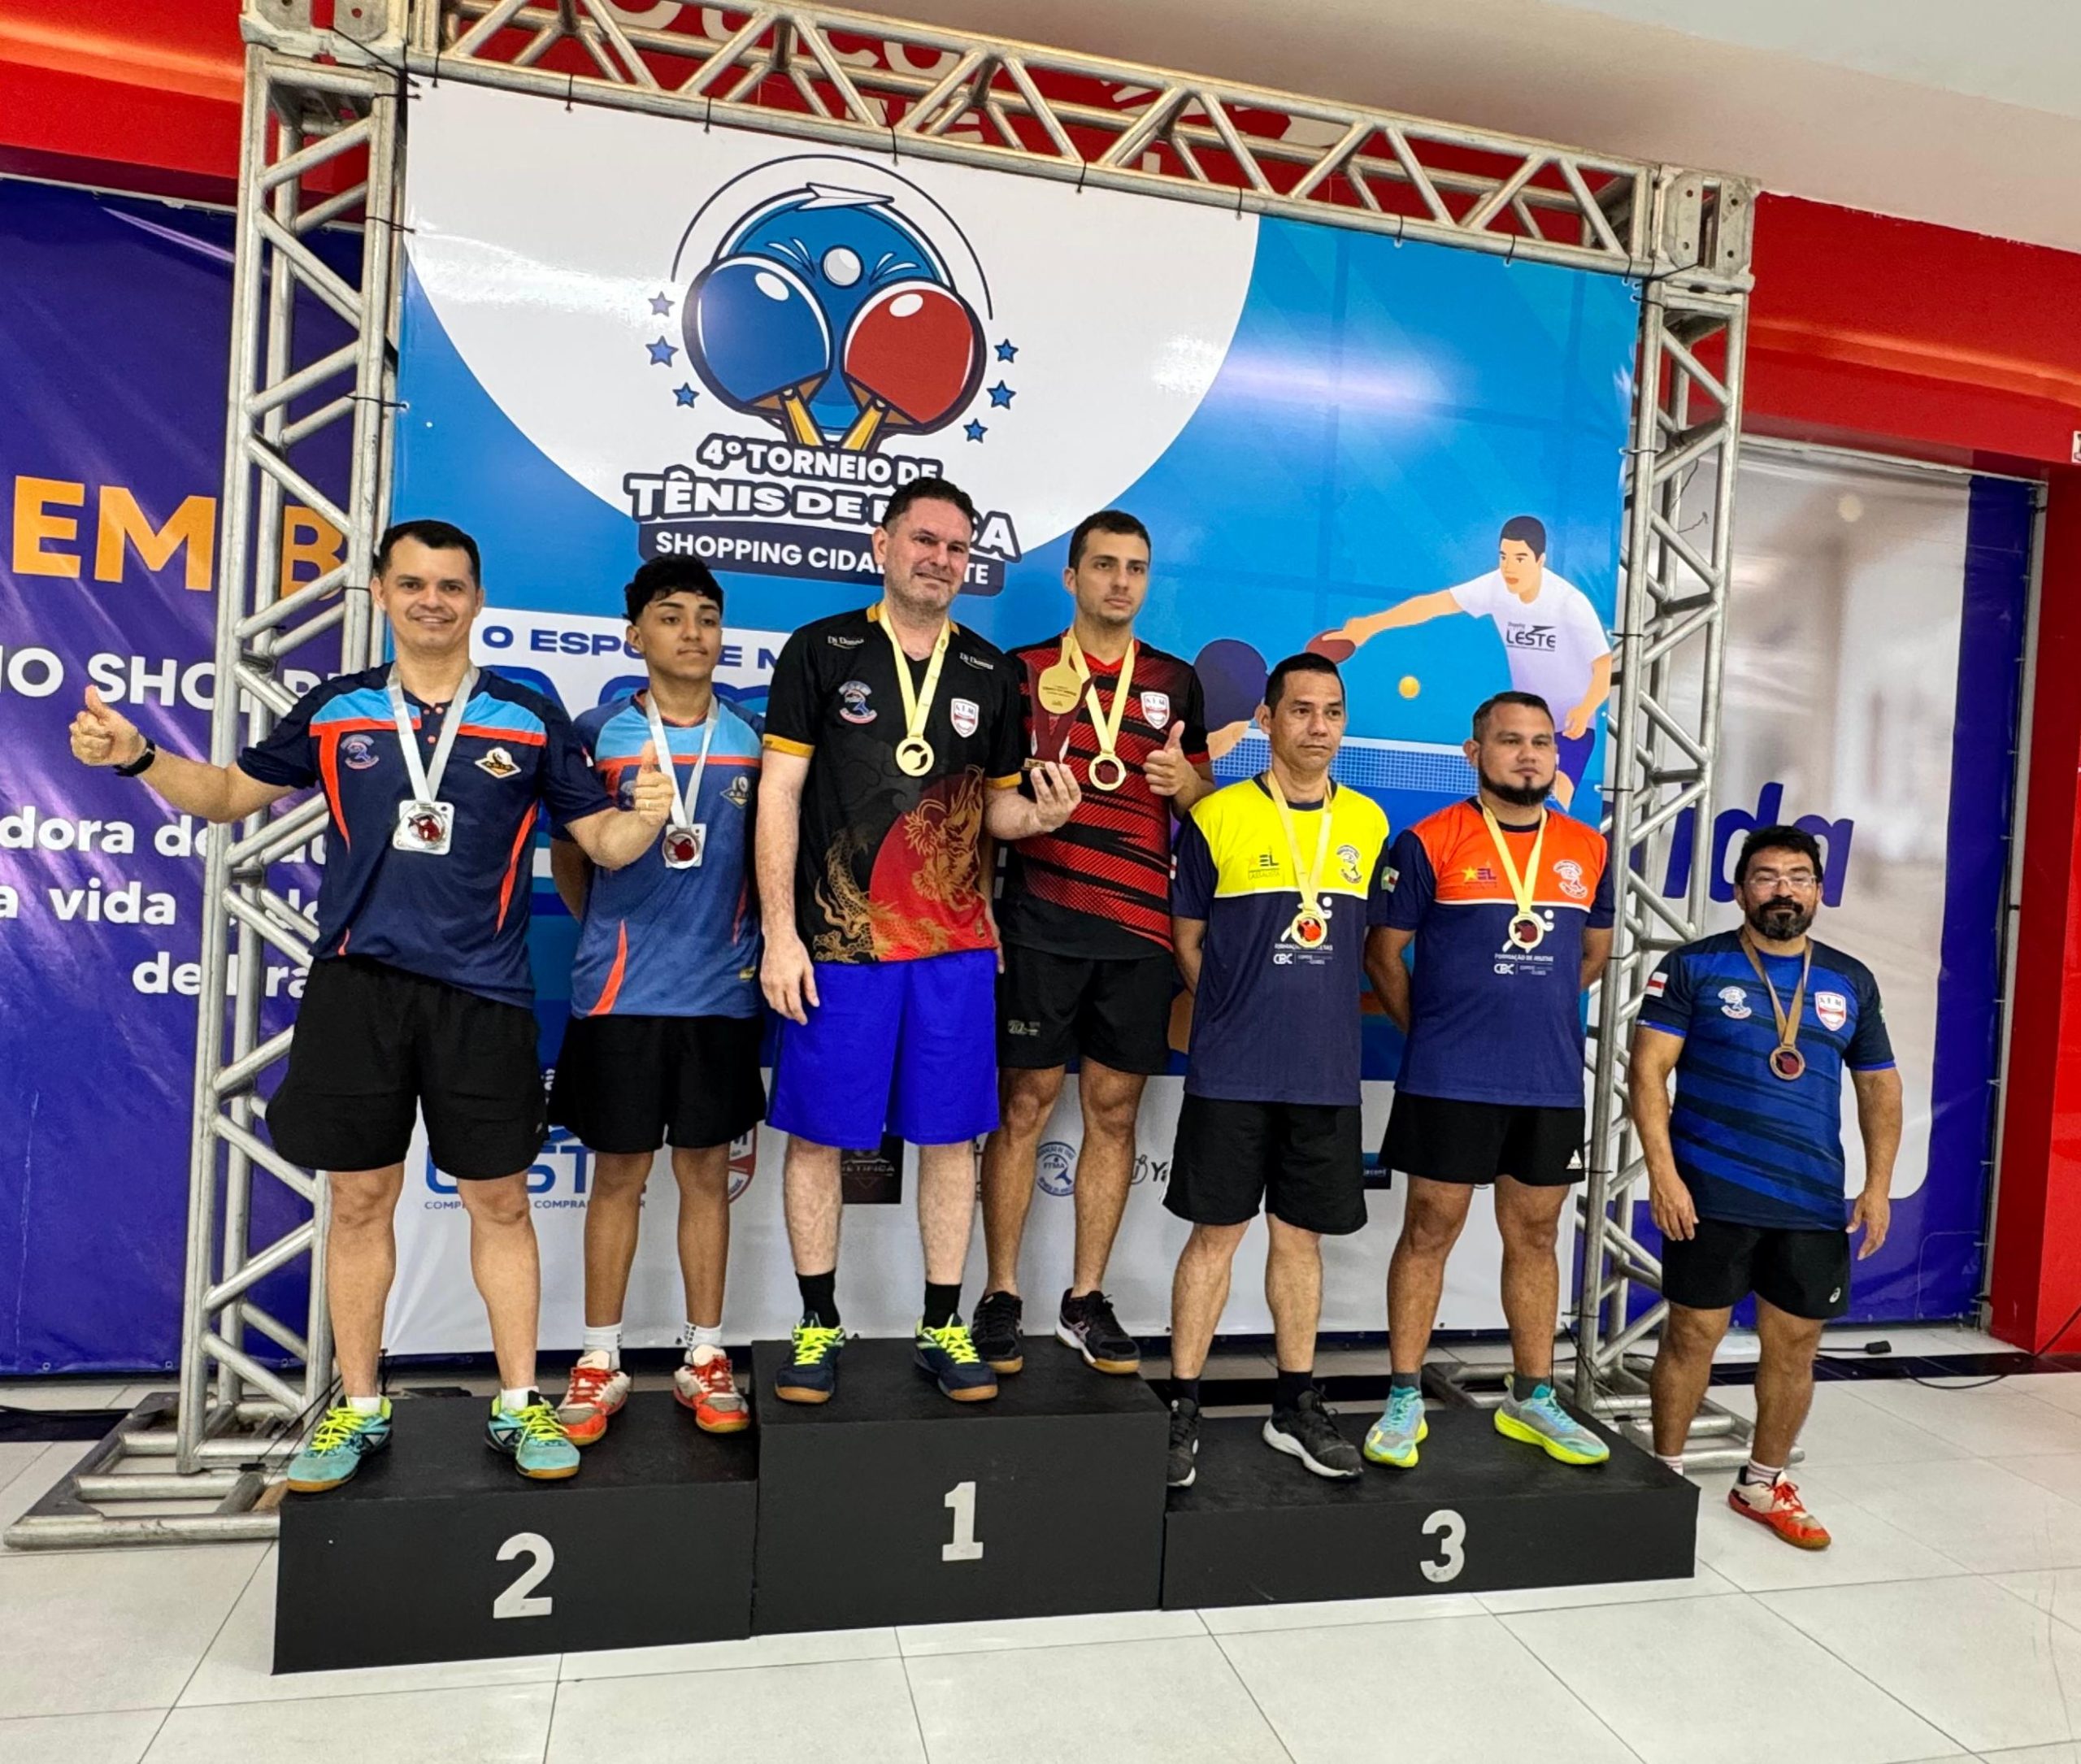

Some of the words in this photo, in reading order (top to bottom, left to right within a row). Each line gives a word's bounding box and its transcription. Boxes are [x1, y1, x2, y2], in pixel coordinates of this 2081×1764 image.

[746, 443, 892, 483] TORNEIO
[897, 460, 938, 485] DE
[629, 470, 786, 517] TÊNIS
[796, 490, 863, 519] DE
[13, 476, 217, 592] EM
[655, 531, 802, 566] SHOPPING
[808, 546, 885, 574] CIDA
[482, 625, 514, 649] O
[1506, 627, 1556, 649] LESTE
[49, 877, 176, 925] vida
[942, 1481, 984, 1561] 1
[1420, 1510, 1466, 1583] 3
[493, 1532, 554, 1618] 2
